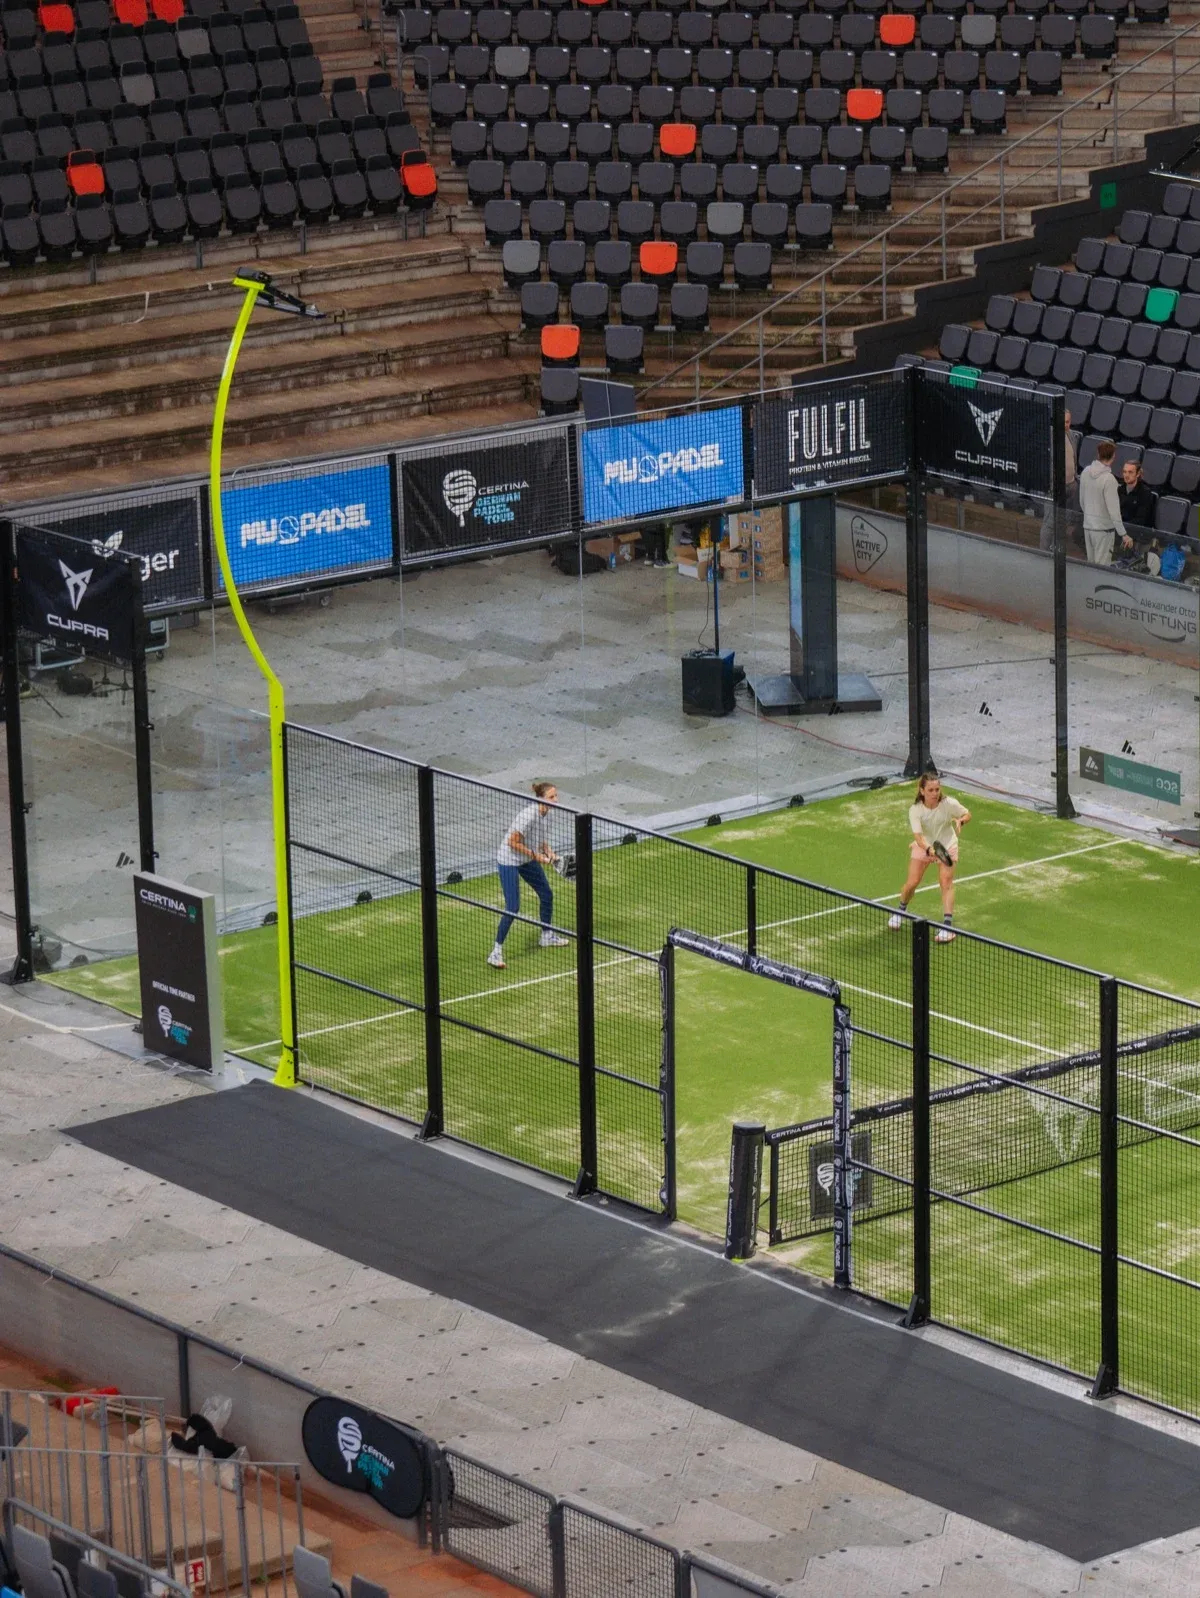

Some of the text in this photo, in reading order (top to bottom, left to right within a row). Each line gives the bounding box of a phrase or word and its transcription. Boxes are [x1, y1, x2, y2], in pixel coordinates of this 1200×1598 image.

[788, 398, 871, 462] FULFIL
[789, 463, 816, 475] PROTEIN
[822, 457, 848, 469] VITAMIN
[849, 454, 871, 464] RIEGEL
[955, 449, 1018, 473] CUPRA
[478, 480, 530, 496] CERTINA
[476, 491, 521, 507] GERMAN
[473, 504, 510, 518] PADEL
[484, 511, 515, 525] TOUR
[855, 540, 881, 553] ACTIVE
[856, 550, 873, 561] CITY
[1085, 597, 1197, 634] SPORTSTIFTUNG
[1140, 597, 1197, 619] Alexander Otto
[46, 613, 110, 641] CUPRA
[139, 888, 187, 913] CERTINA
[929, 1091, 953, 1101] ERTINA
[771, 1127, 801, 1139] CERTINA
[362, 1443, 396, 1472] CERTINA
